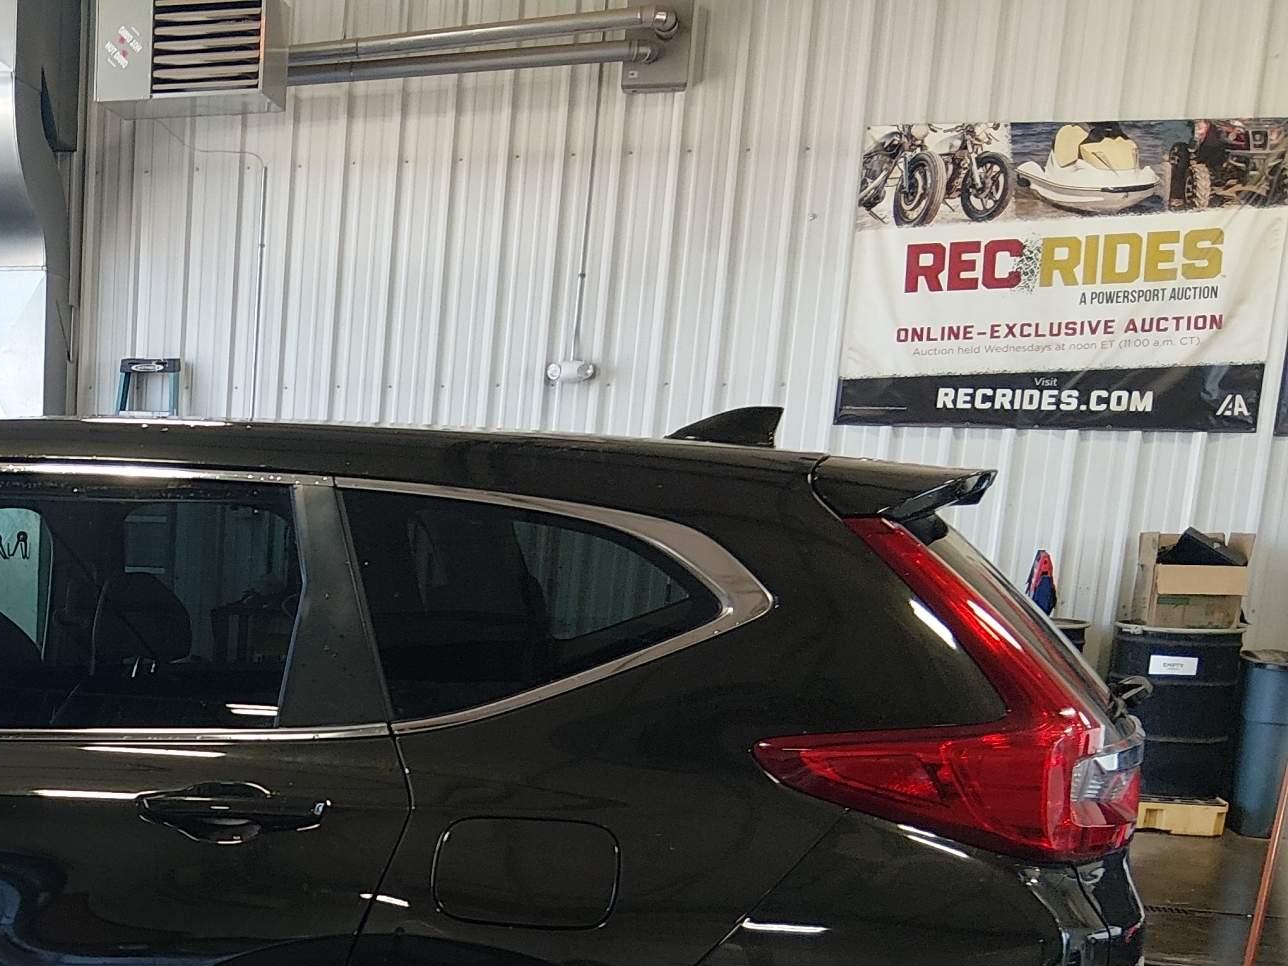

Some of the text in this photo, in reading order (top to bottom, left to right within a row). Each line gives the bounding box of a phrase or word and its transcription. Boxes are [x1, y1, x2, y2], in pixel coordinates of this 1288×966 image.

[904, 228, 1225, 293] REC RIDES
[1079, 285, 1219, 306] A POWERSPORT AUCTION
[896, 314, 1224, 343] ONLINE-EXCLUSIVE AUCTION
[912, 346, 954, 357] Auction
[958, 345, 981, 355] held
[984, 343, 1052, 354] Wednesdays
[1054, 343, 1065, 351] at
[1069, 342, 1097, 351] noon
[1100, 340, 1115, 350] ET
[1179, 336, 1201, 346] CT)
[1034, 377, 1058, 387] Visit
[935, 388, 1154, 412] RECRIDES.COM
